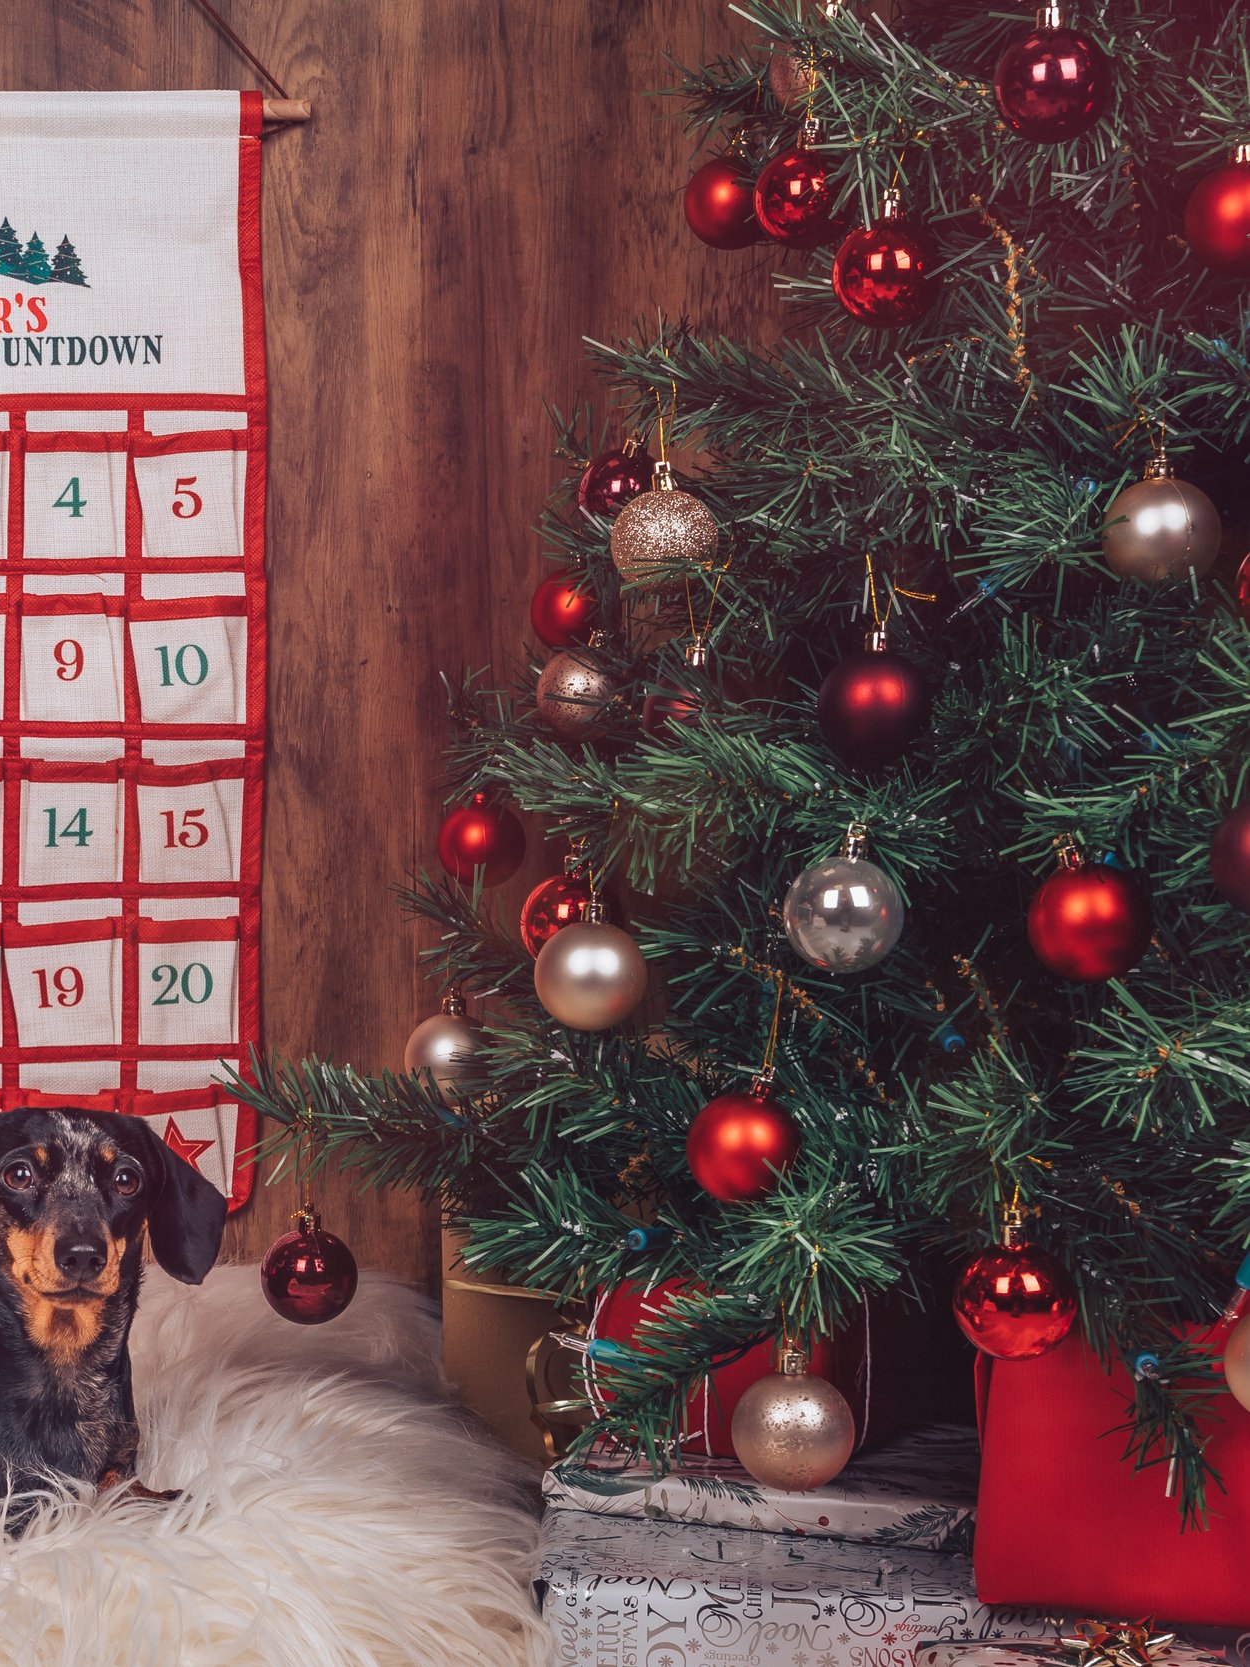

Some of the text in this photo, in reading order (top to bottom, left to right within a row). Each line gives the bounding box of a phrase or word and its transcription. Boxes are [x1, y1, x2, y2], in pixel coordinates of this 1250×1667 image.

[52, 477, 87, 518] 4
[171, 476, 203, 519] 5
[53, 639, 84, 682] 9
[154, 644, 209, 687] 10
[42, 807, 94, 848] 14
[159, 808, 209, 849] 15
[31, 965, 85, 1009] 19
[151, 962, 214, 1006] 20
[580, 1573, 697, 1602] Noel
[703, 1649, 761, 1666] Greetings
[743, 1620, 833, 1656] Noel
